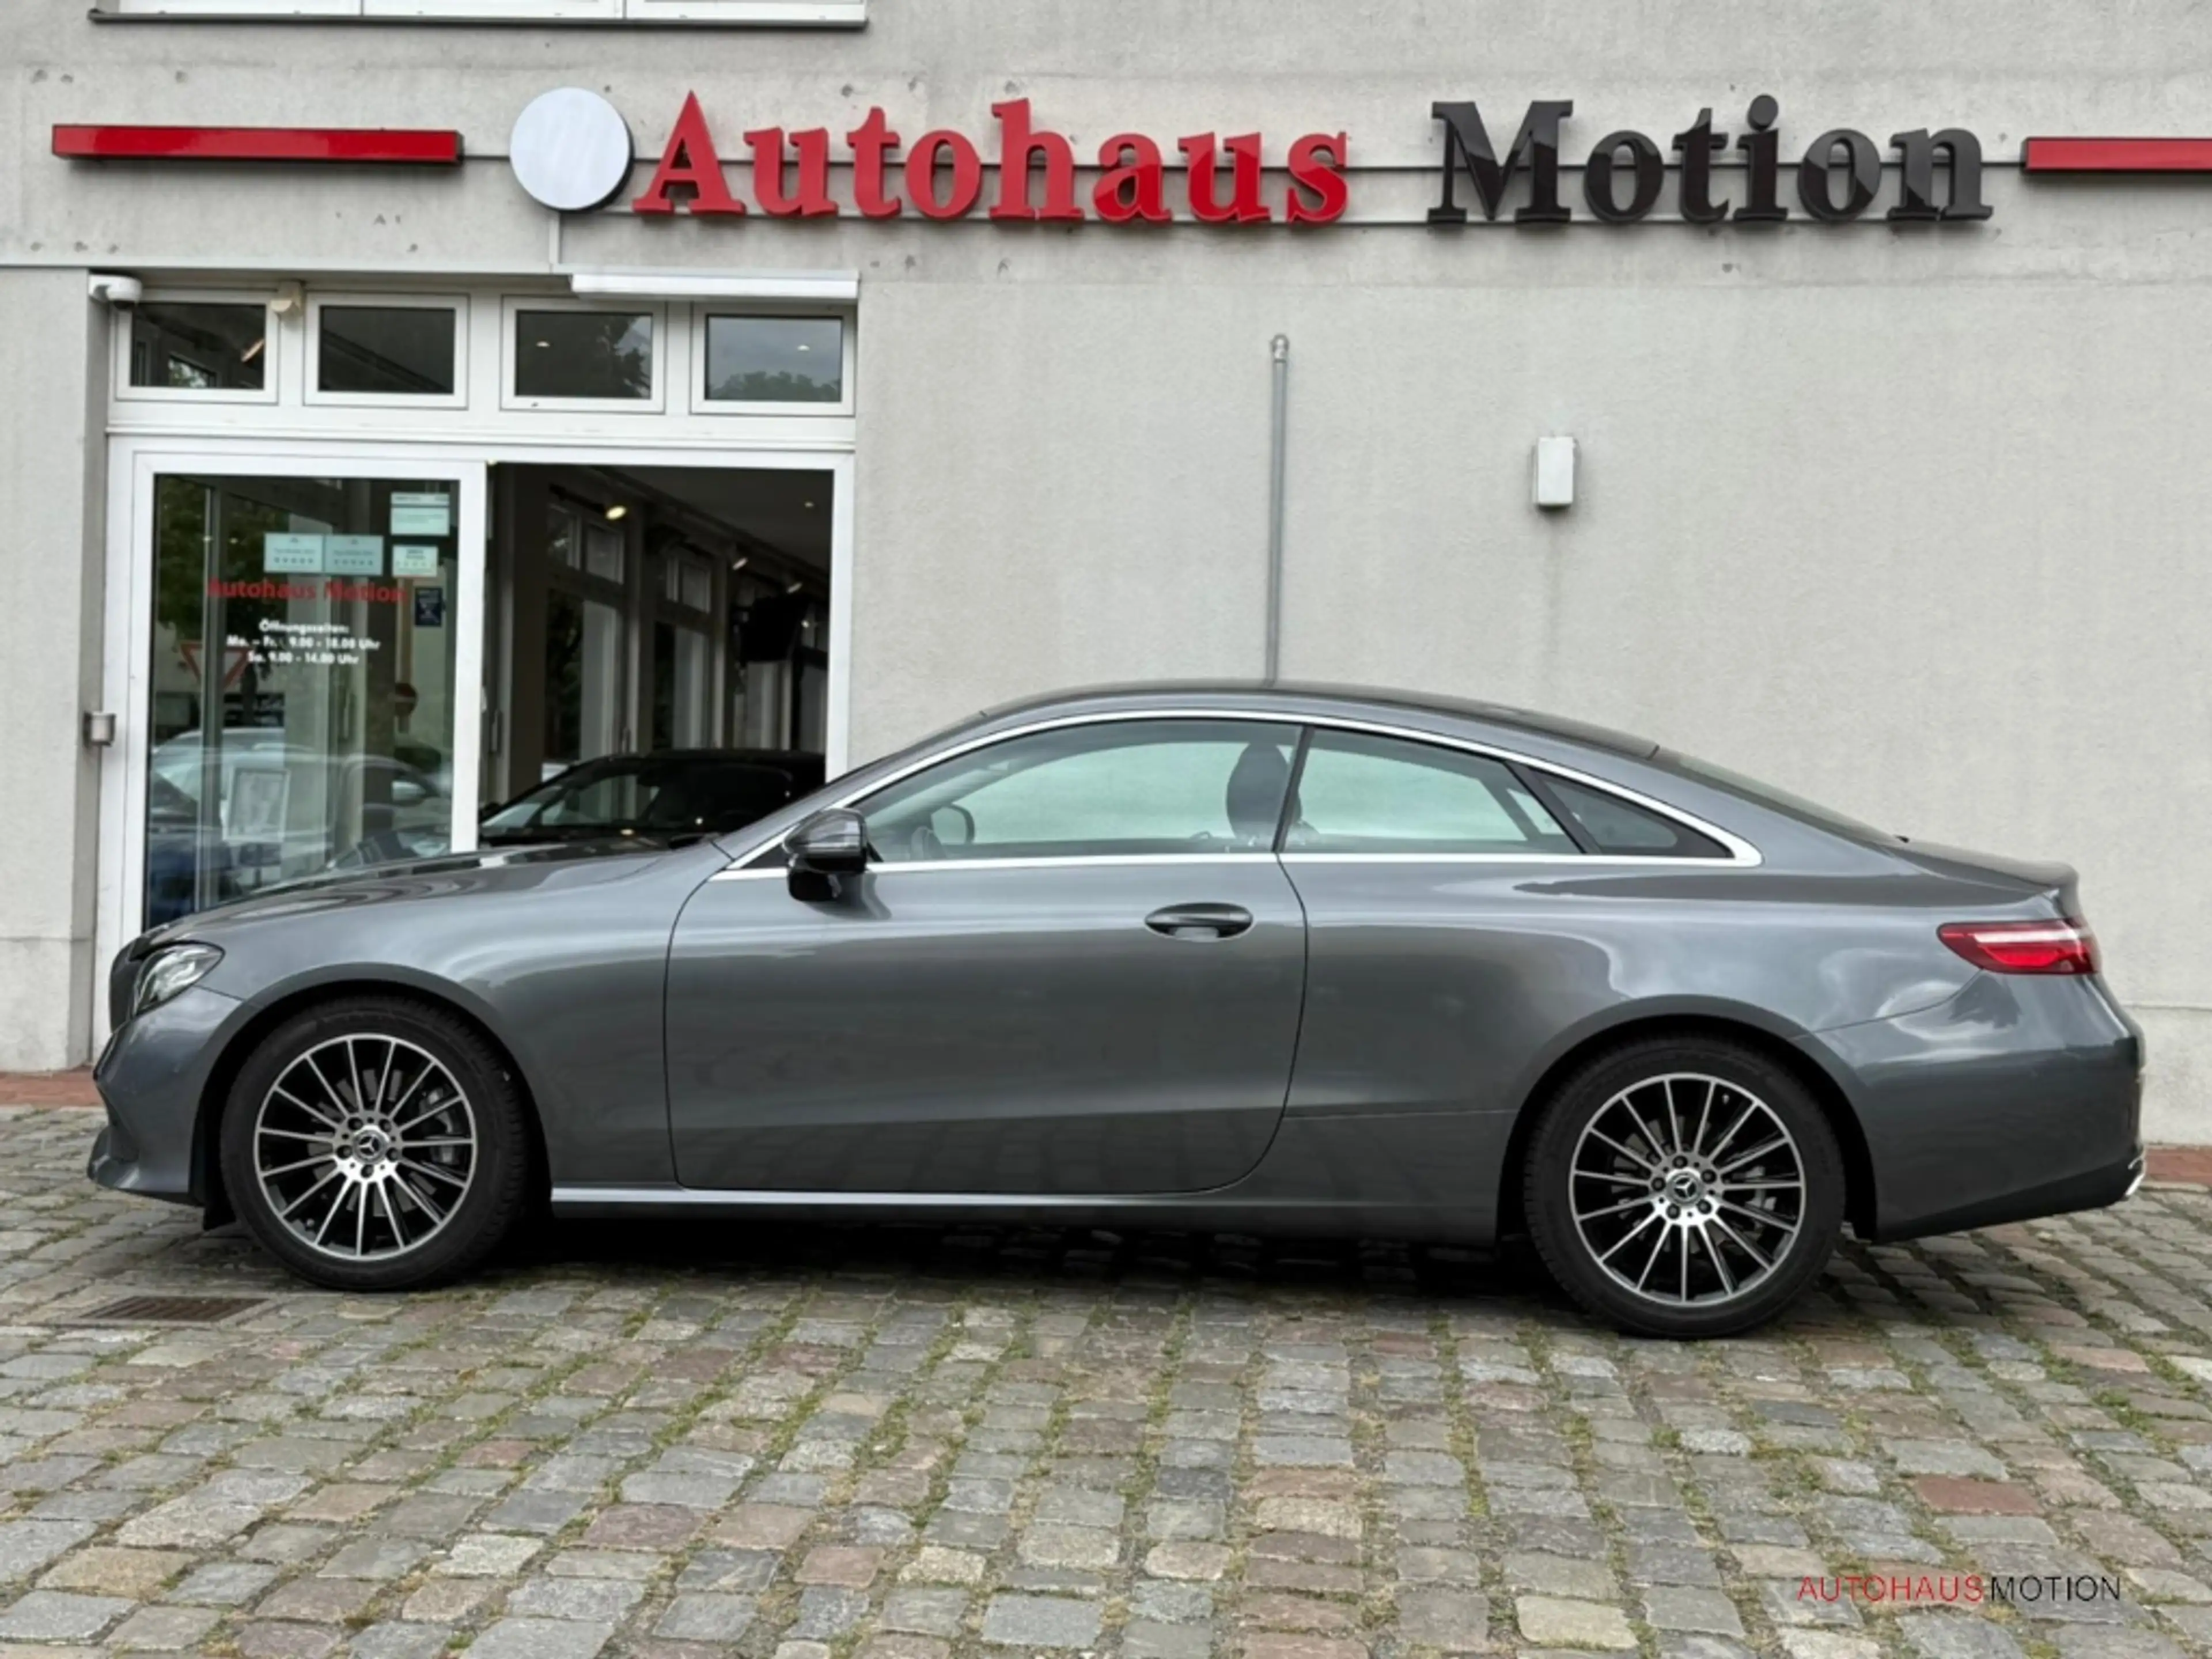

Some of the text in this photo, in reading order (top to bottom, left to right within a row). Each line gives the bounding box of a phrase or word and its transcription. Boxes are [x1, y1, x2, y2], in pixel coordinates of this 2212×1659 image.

[633, 90, 1993, 224] Autohaus Motion
[207, 578, 316, 599] Autohaus
